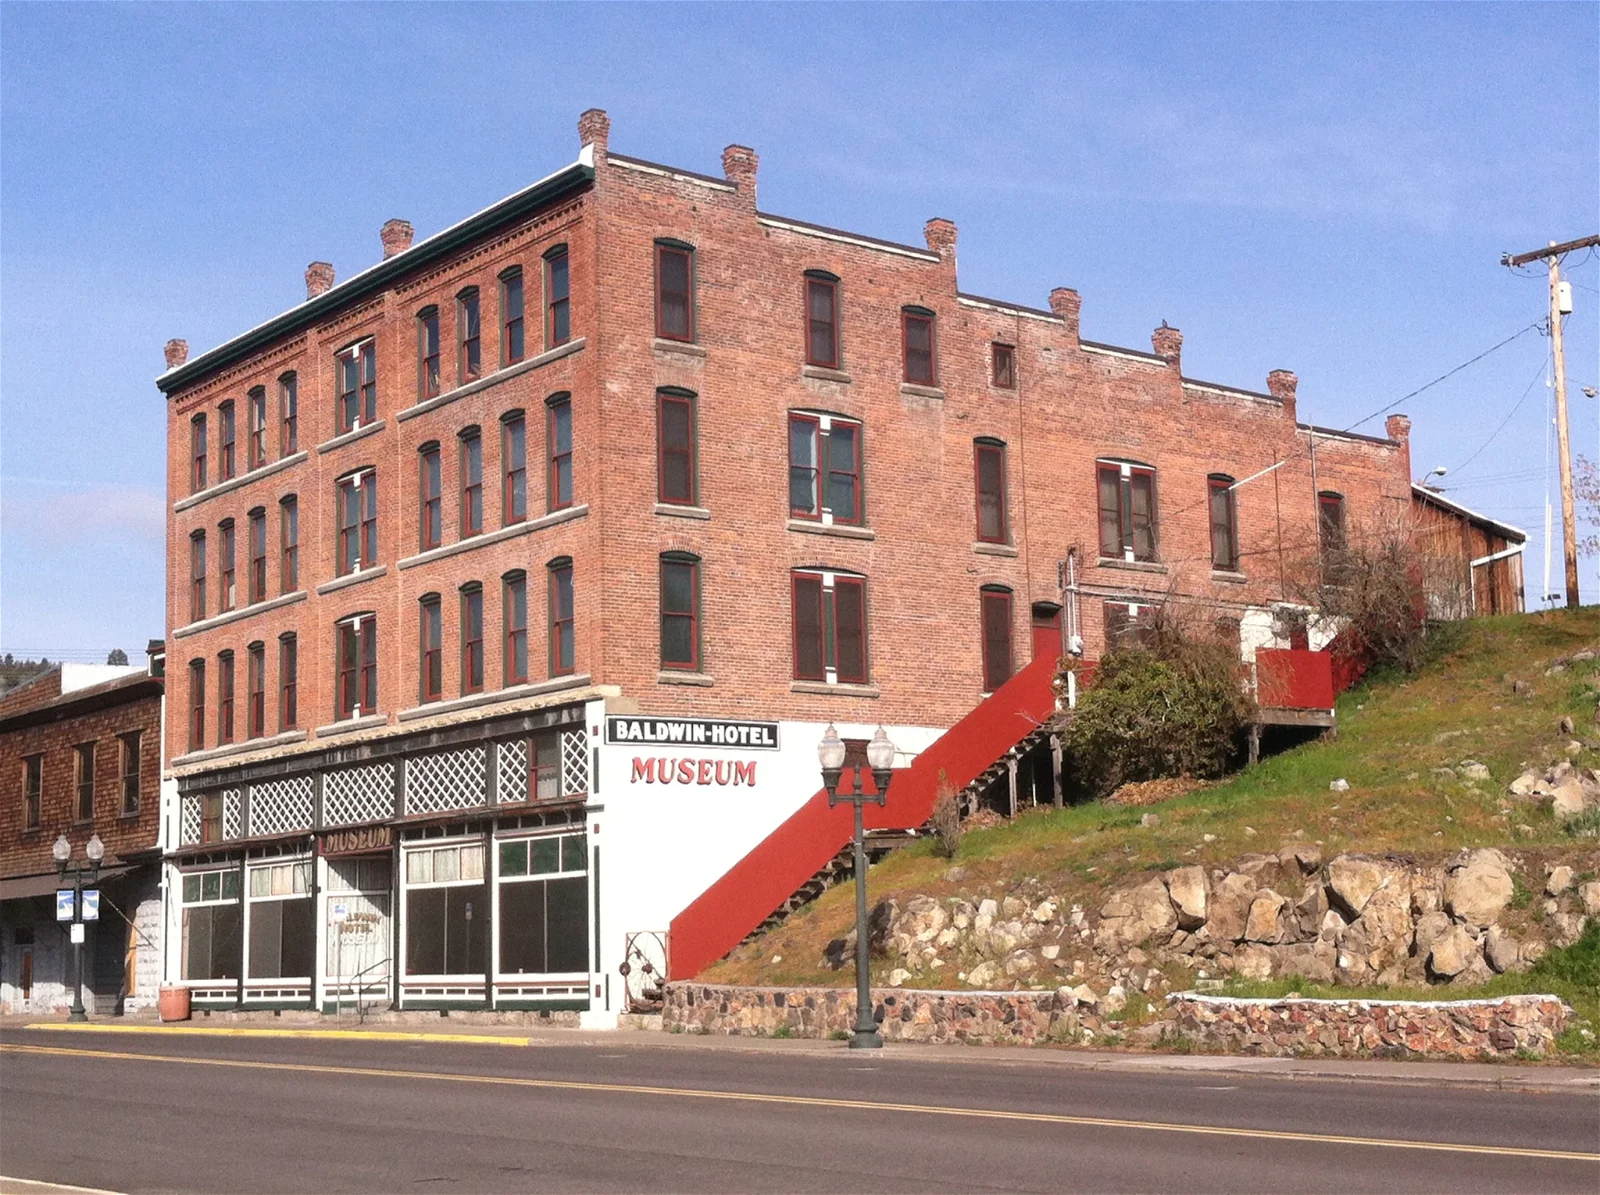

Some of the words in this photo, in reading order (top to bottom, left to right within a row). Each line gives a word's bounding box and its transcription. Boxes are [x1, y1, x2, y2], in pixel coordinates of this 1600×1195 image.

[616, 720, 774, 745] BALDWIN-HOTEL
[630, 756, 757, 787] MUSEUM
[325, 827, 391, 853] MUSEUM
